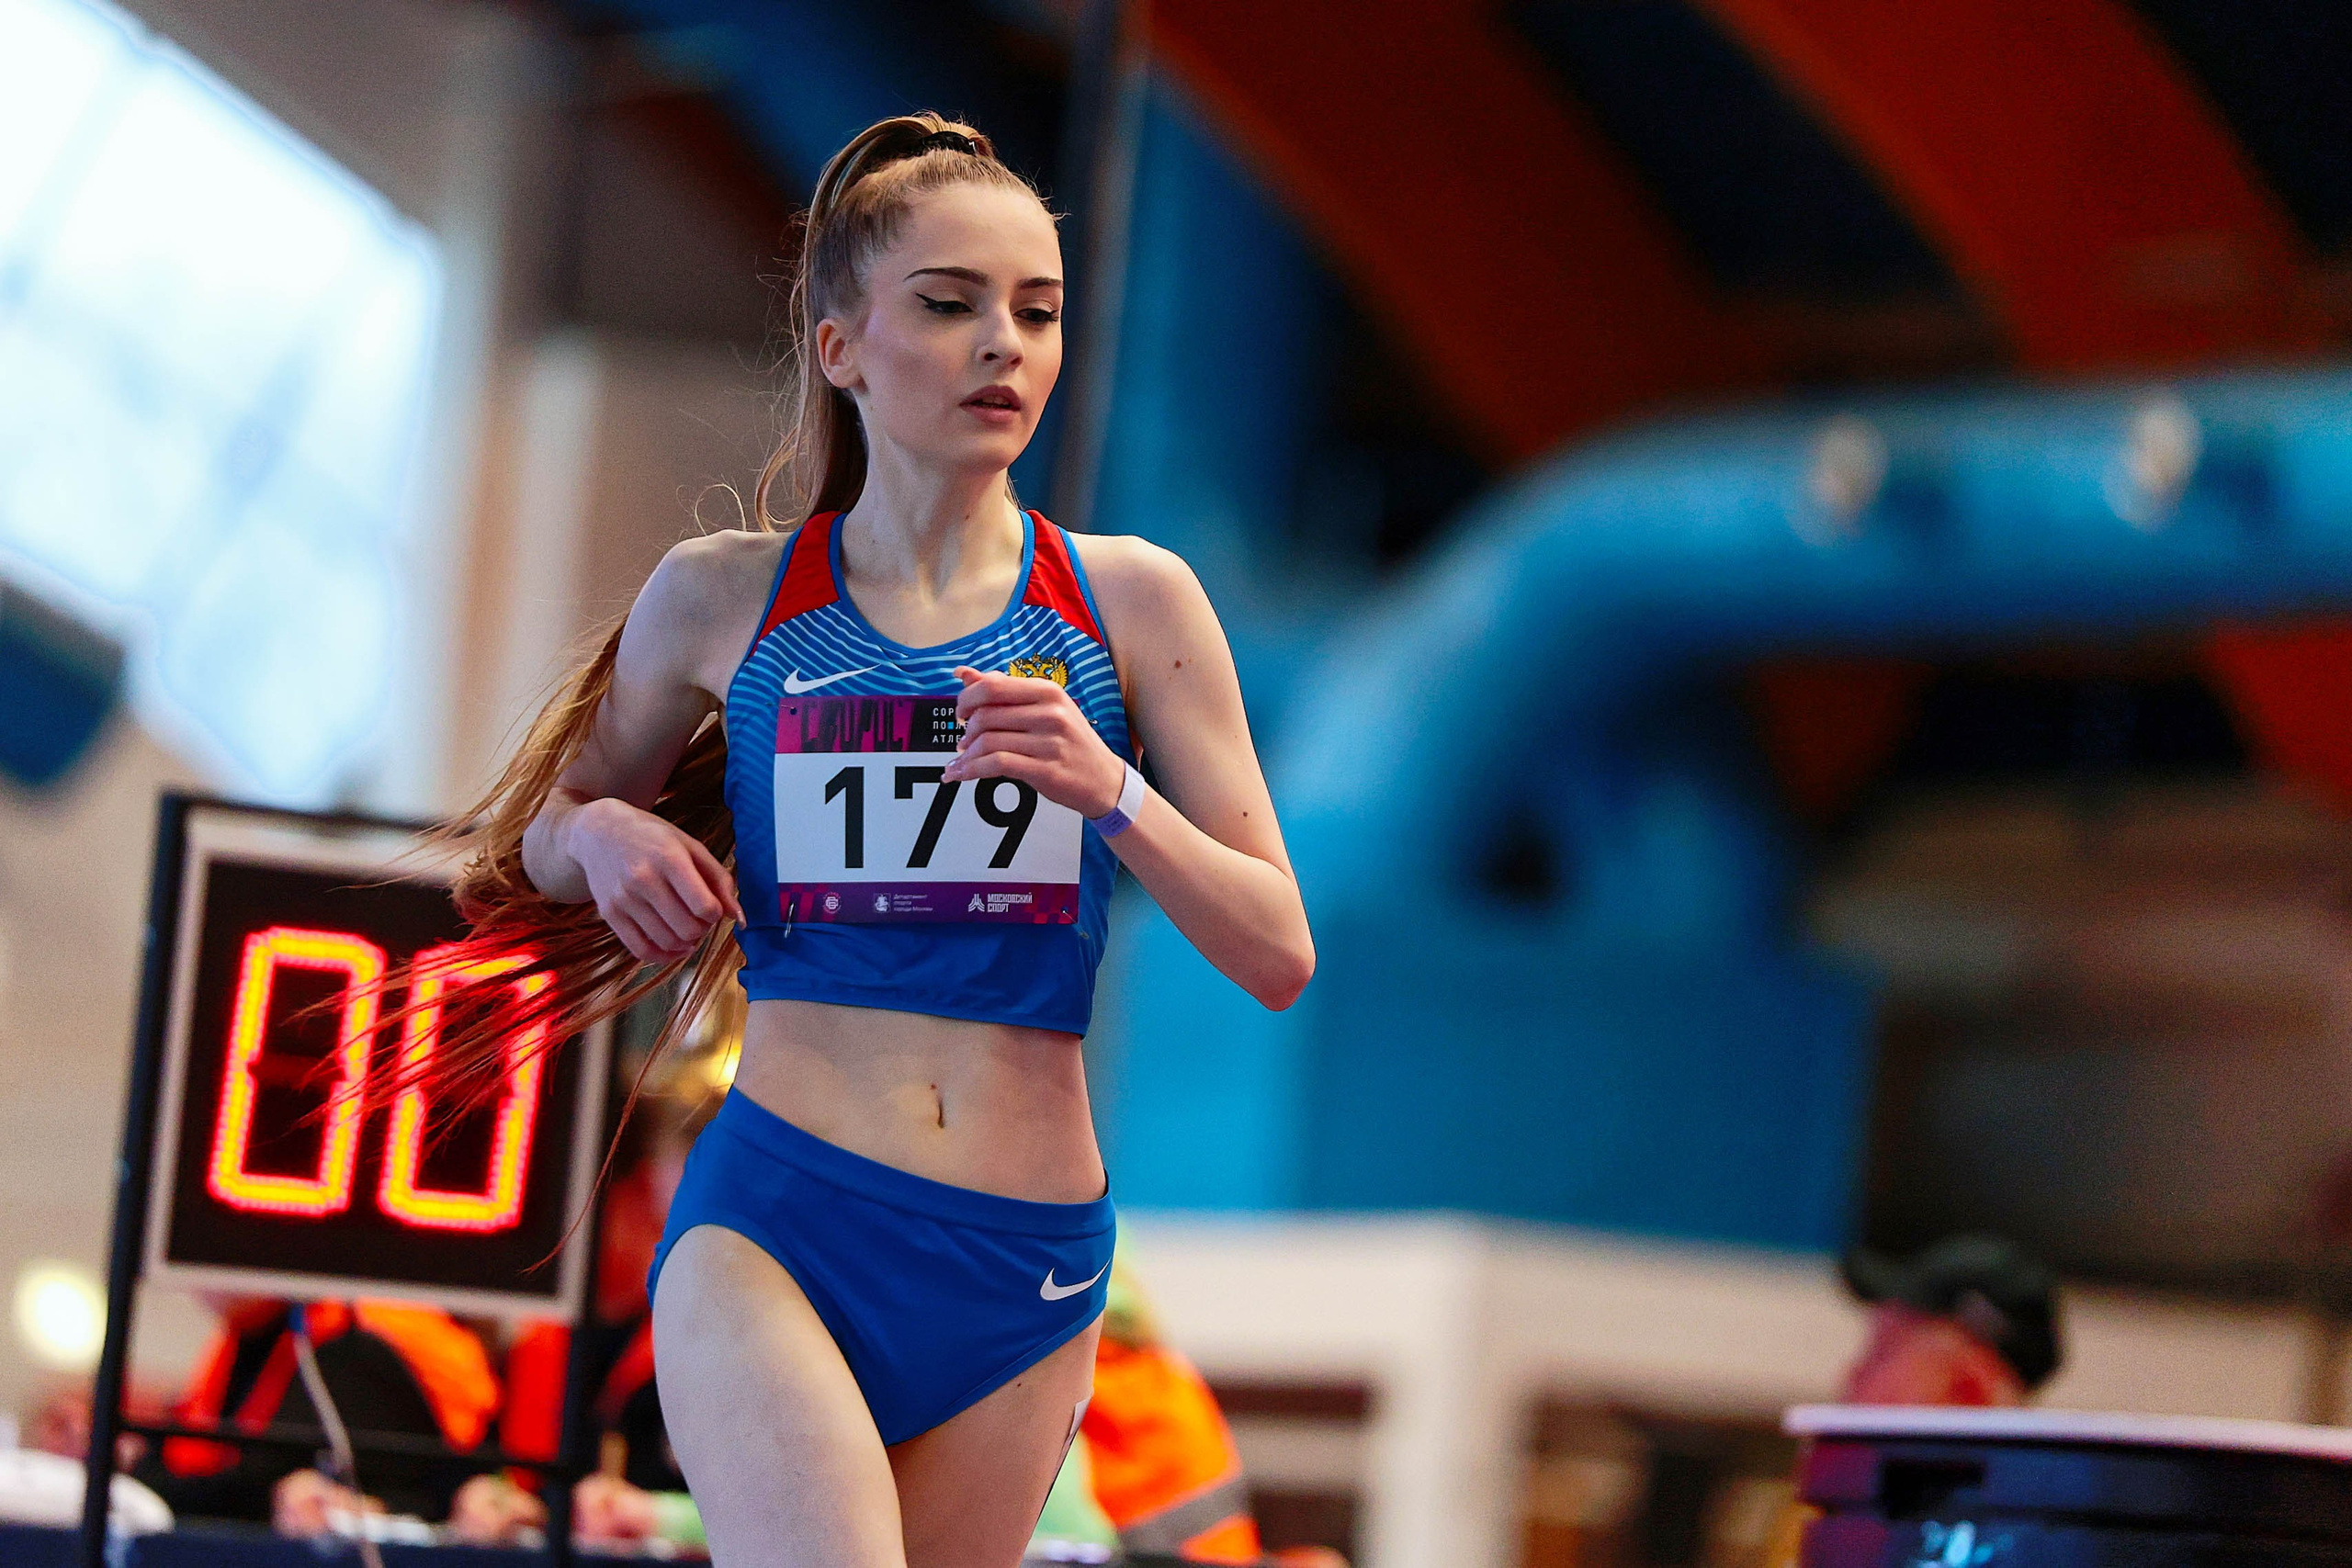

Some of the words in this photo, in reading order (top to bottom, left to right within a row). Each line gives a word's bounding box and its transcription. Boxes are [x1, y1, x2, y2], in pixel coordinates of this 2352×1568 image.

[824, 766, 1038, 869] 179
[987, 892, 1033, 904] МОСКОВСКИЙ
[208, 925, 557, 1235] 00
